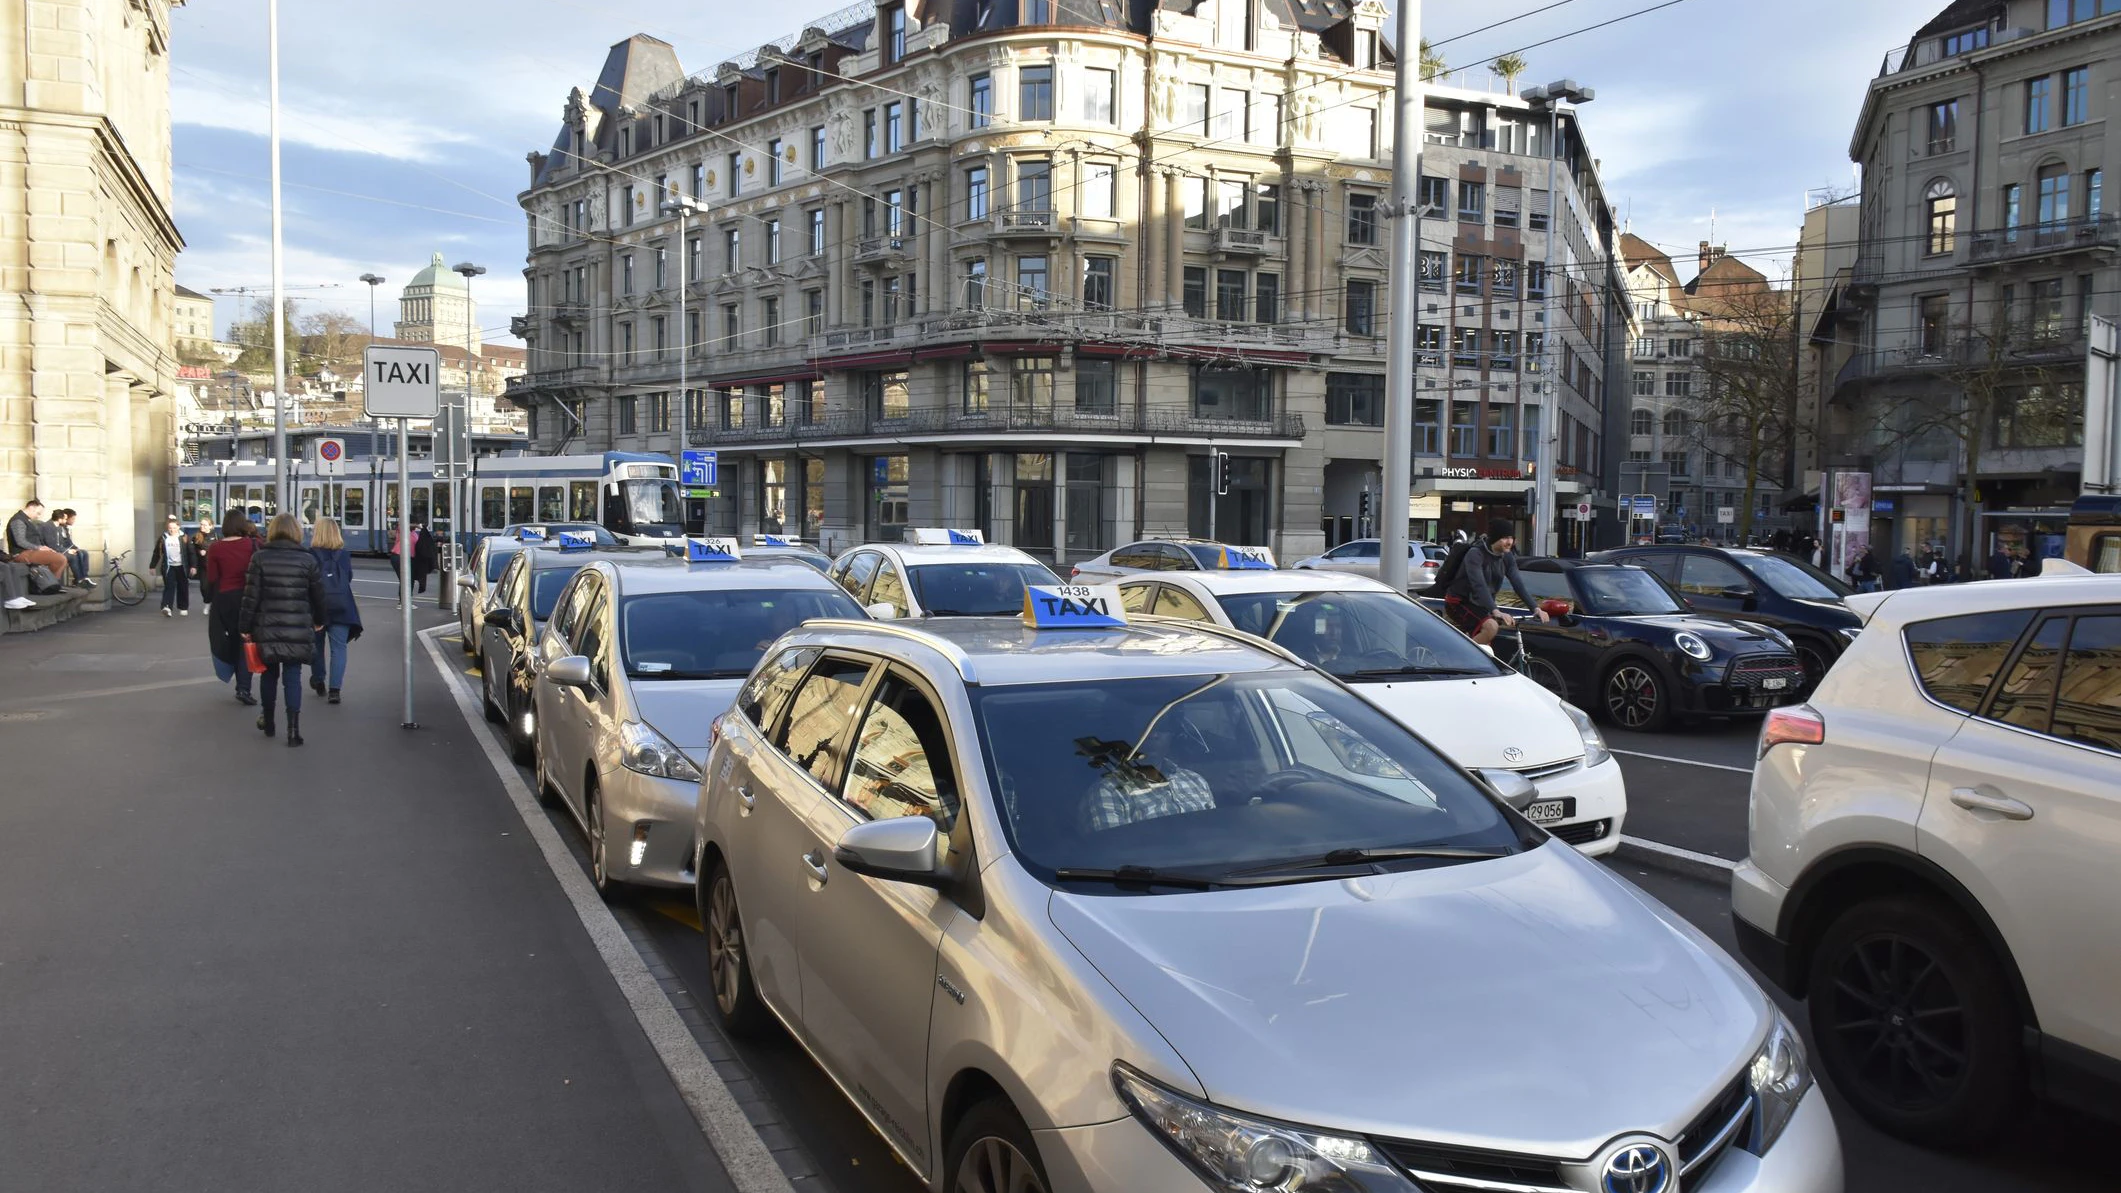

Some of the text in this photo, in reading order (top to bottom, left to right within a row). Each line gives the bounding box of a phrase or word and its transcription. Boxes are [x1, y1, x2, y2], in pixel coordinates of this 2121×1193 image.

[373, 361, 430, 384] TAXI
[564, 537, 591, 545] TAXI
[953, 534, 978, 543] TAXI
[694, 544, 731, 555] TAXI
[1230, 552, 1266, 562] TAXI
[1057, 586, 1090, 596] 1438
[1040, 597, 1109, 616] TAXI
[1544, 804, 1561, 817] 056
